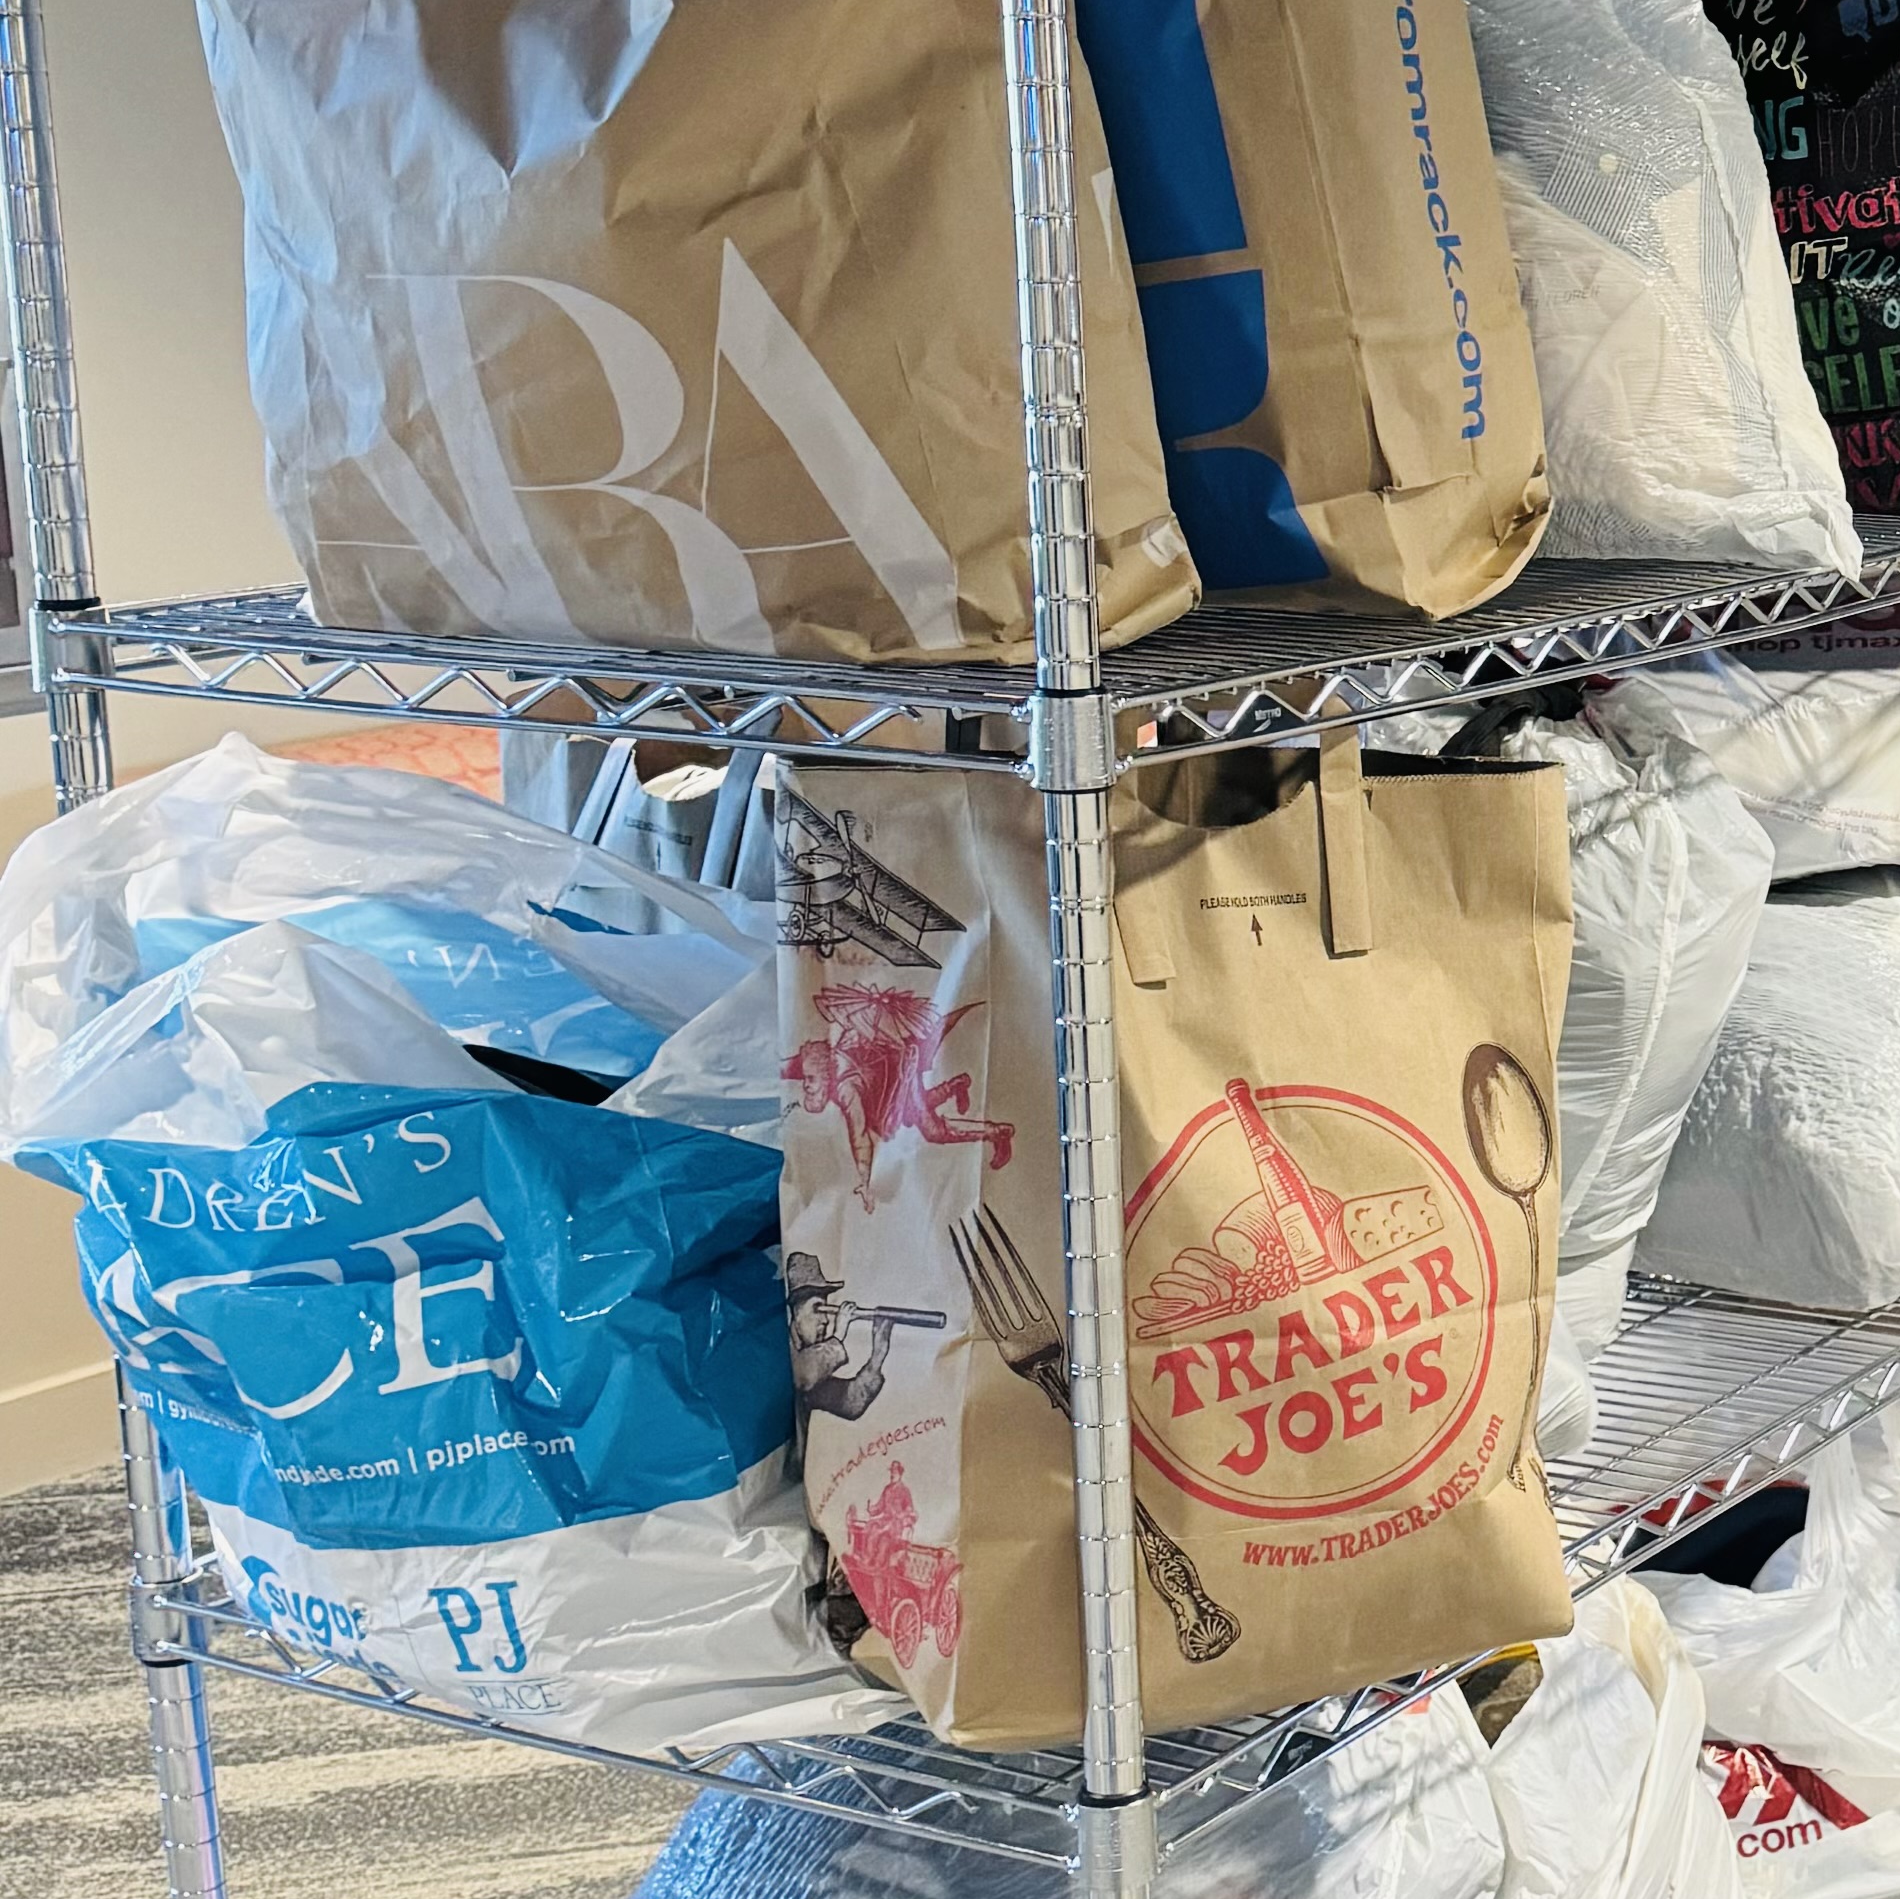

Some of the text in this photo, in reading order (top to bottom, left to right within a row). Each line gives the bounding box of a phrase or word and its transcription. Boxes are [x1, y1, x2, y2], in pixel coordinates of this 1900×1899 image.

[1151, 1245, 1474, 1419] TRADER
[1217, 1333, 1449, 1476] JOE'S
[427, 1580, 528, 1675] PJ
[468, 1682, 563, 1712] PLACE
